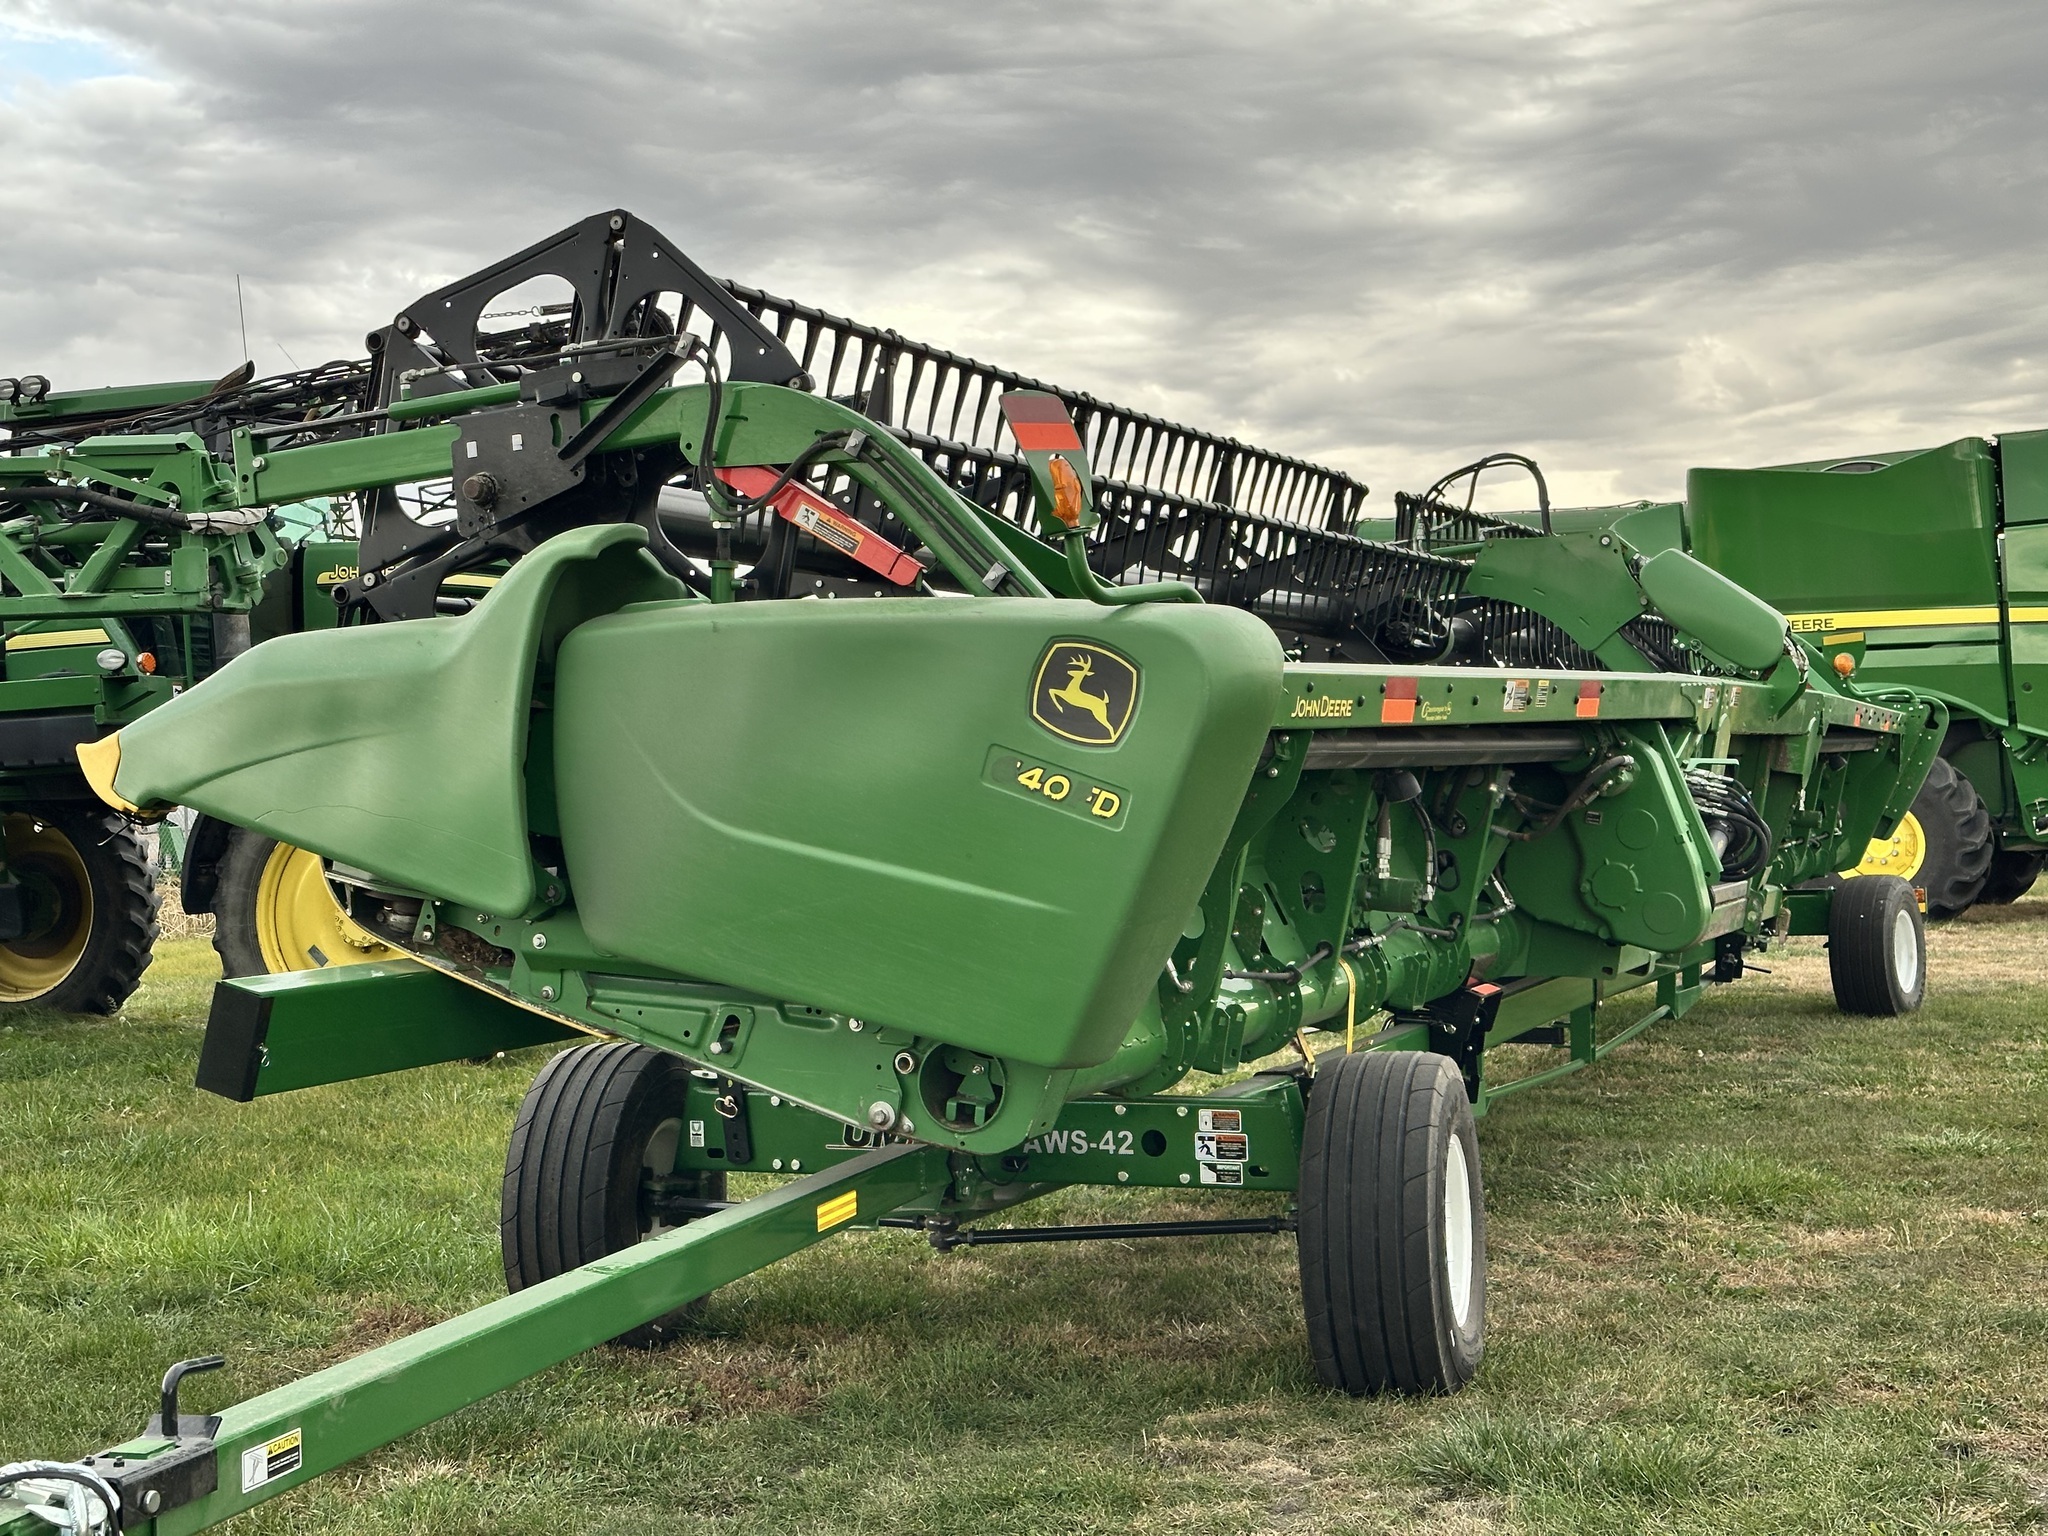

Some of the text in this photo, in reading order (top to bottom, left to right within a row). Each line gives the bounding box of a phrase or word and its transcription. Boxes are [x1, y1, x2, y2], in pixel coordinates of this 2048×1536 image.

[330, 563, 360, 579] JOH
[1291, 695, 1354, 718] JOHN DEERE
[1015, 760, 1072, 801] 40
[272, 1435, 299, 1453] CAUTION
